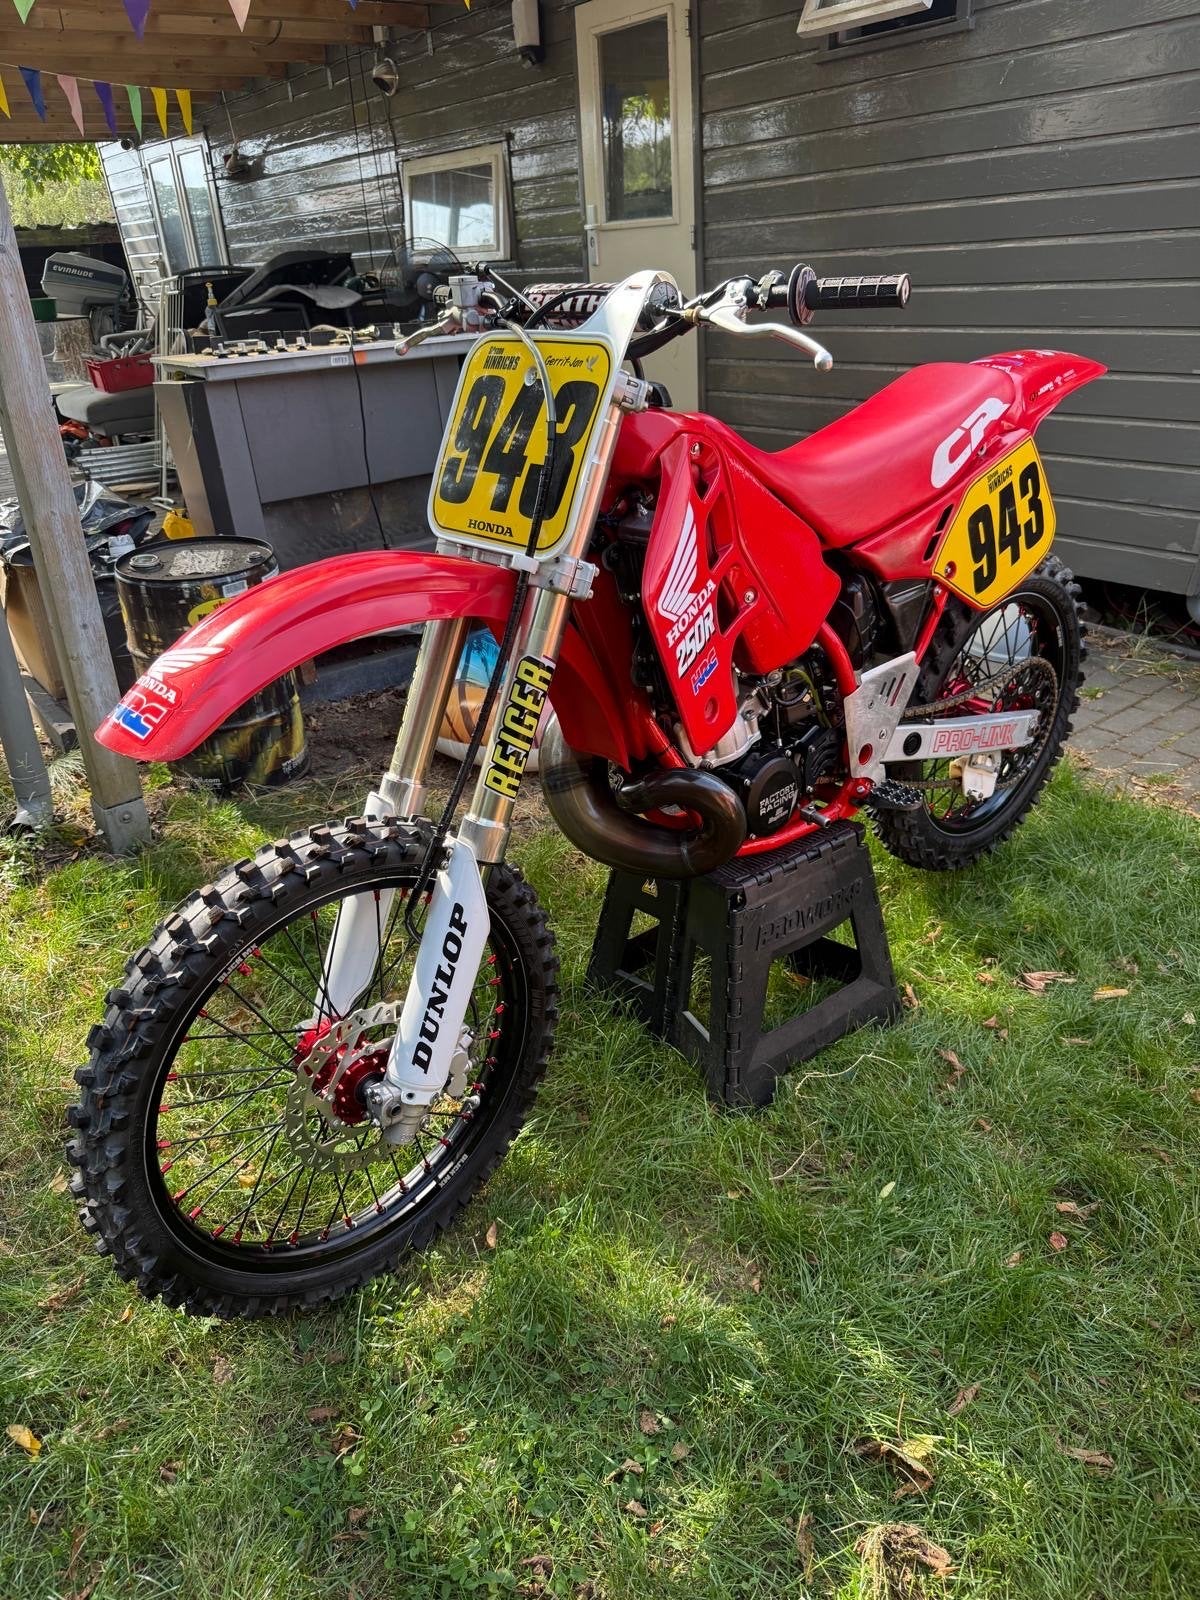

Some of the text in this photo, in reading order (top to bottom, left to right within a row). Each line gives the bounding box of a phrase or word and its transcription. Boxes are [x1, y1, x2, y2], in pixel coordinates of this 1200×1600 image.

[52, 264, 95, 279] EVINRUDE
[483, 355, 521, 371] HINRICHS
[439, 374, 600, 521] 943
[930, 397, 1012, 489] CR
[987, 465, 1013, 495] HINRICHS
[467, 518, 514, 538] HONDA
[967, 461, 1045, 595] 943
[665, 579, 717, 649] HONDA
[675, 602, 716, 680] 250R
[484, 655, 554, 800] REIGER
[932, 722, 1017, 753] PRO-LINK
[760, 782, 795, 809] FACTORY
[760, 791, 795, 817] RACING
[411, 902, 468, 1075] DUNLOP
